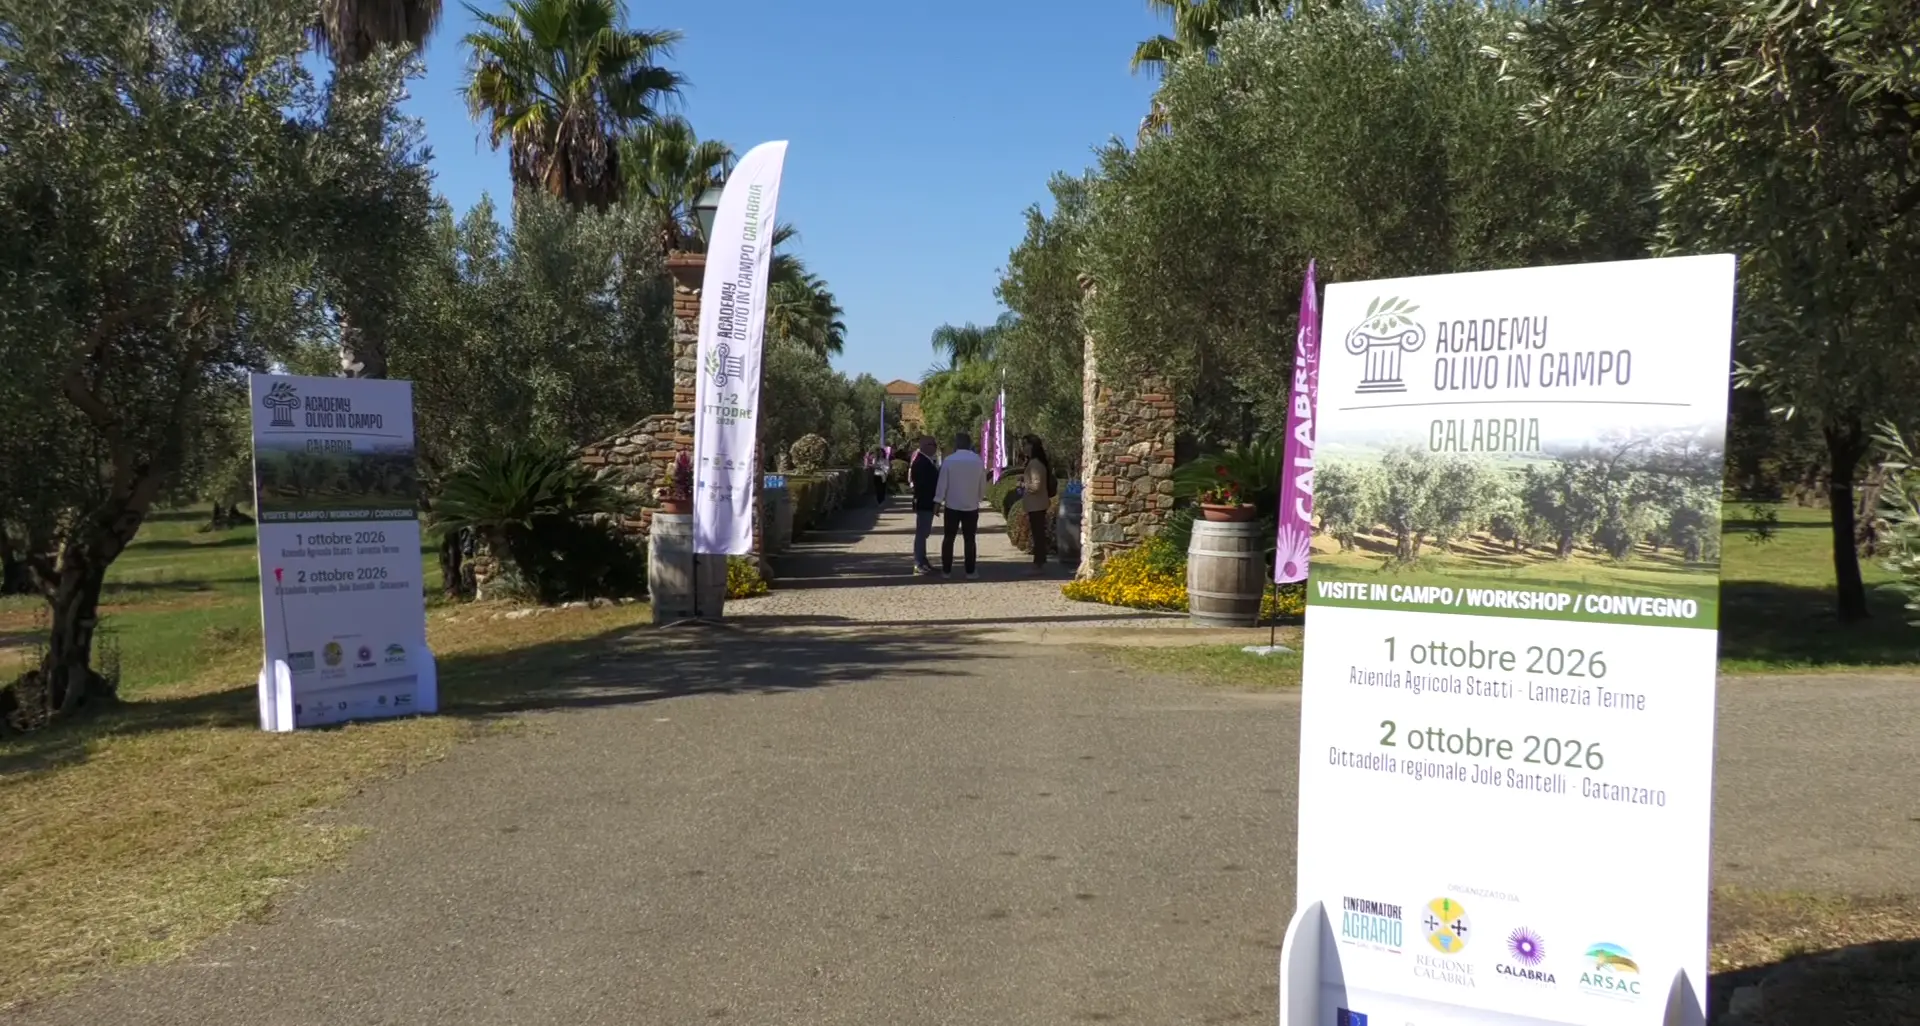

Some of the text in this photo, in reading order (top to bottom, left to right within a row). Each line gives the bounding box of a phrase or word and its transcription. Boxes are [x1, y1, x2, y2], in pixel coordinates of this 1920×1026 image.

[734, 184, 763, 341] OLIVO IN CAMPO CALABRIA
[717, 282, 737, 339] ACADEMY
[1435, 315, 1548, 354] ACADEMY
[1433, 349, 1632, 391] OLIVO IN CAMPO
[305, 396, 351, 412] ACADEMY
[716, 392, 739, 405] 1-2
[305, 413, 383, 429] OLIVO IN CAMPO
[307, 439, 352, 454] CALABRIA
[1429, 417, 1540, 452] CALABRIA
[297, 510, 325, 519] CAMPO
[296, 531, 386, 546] 1 ottobre 2026
[298, 567, 388, 583] 2 ottobre 2026
[1317, 580, 1698, 619] VISITE IN CAMPO / WORKSHOP / CONVEGNO
[1384, 636, 1608, 679] 1 ottobre 2026
[1349, 665, 1401, 689] Azienda
[1404, 669, 1462, 695] Agricola
[1466, 675, 1513, 699] Statti
[1528, 681, 1592, 707] Lamezia
[1596, 686, 1646, 711] Terme
[1379, 719, 1605, 770] 2 ottobre 2026
[1329, 746, 1397, 773] Cittadella
[1400, 756, 1467, 781] regionale
[1471, 763, 1502, 787] Jole
[1506, 768, 1567, 795] Santelli
[1582, 776, 1666, 807] Catanzaro
[1447, 883, 1507, 900] ORGANIZZATO
[1343, 896, 1403, 921] L'INFORMATORE
[1342, 910, 1403, 948] AGRARIO
[1416, 954, 1475, 975] REGIONE
[1495, 963, 1557, 985] CALABRIA
[1413, 965, 1476, 989] CALABRIA
[1579, 971, 1641, 995] ARSAC
